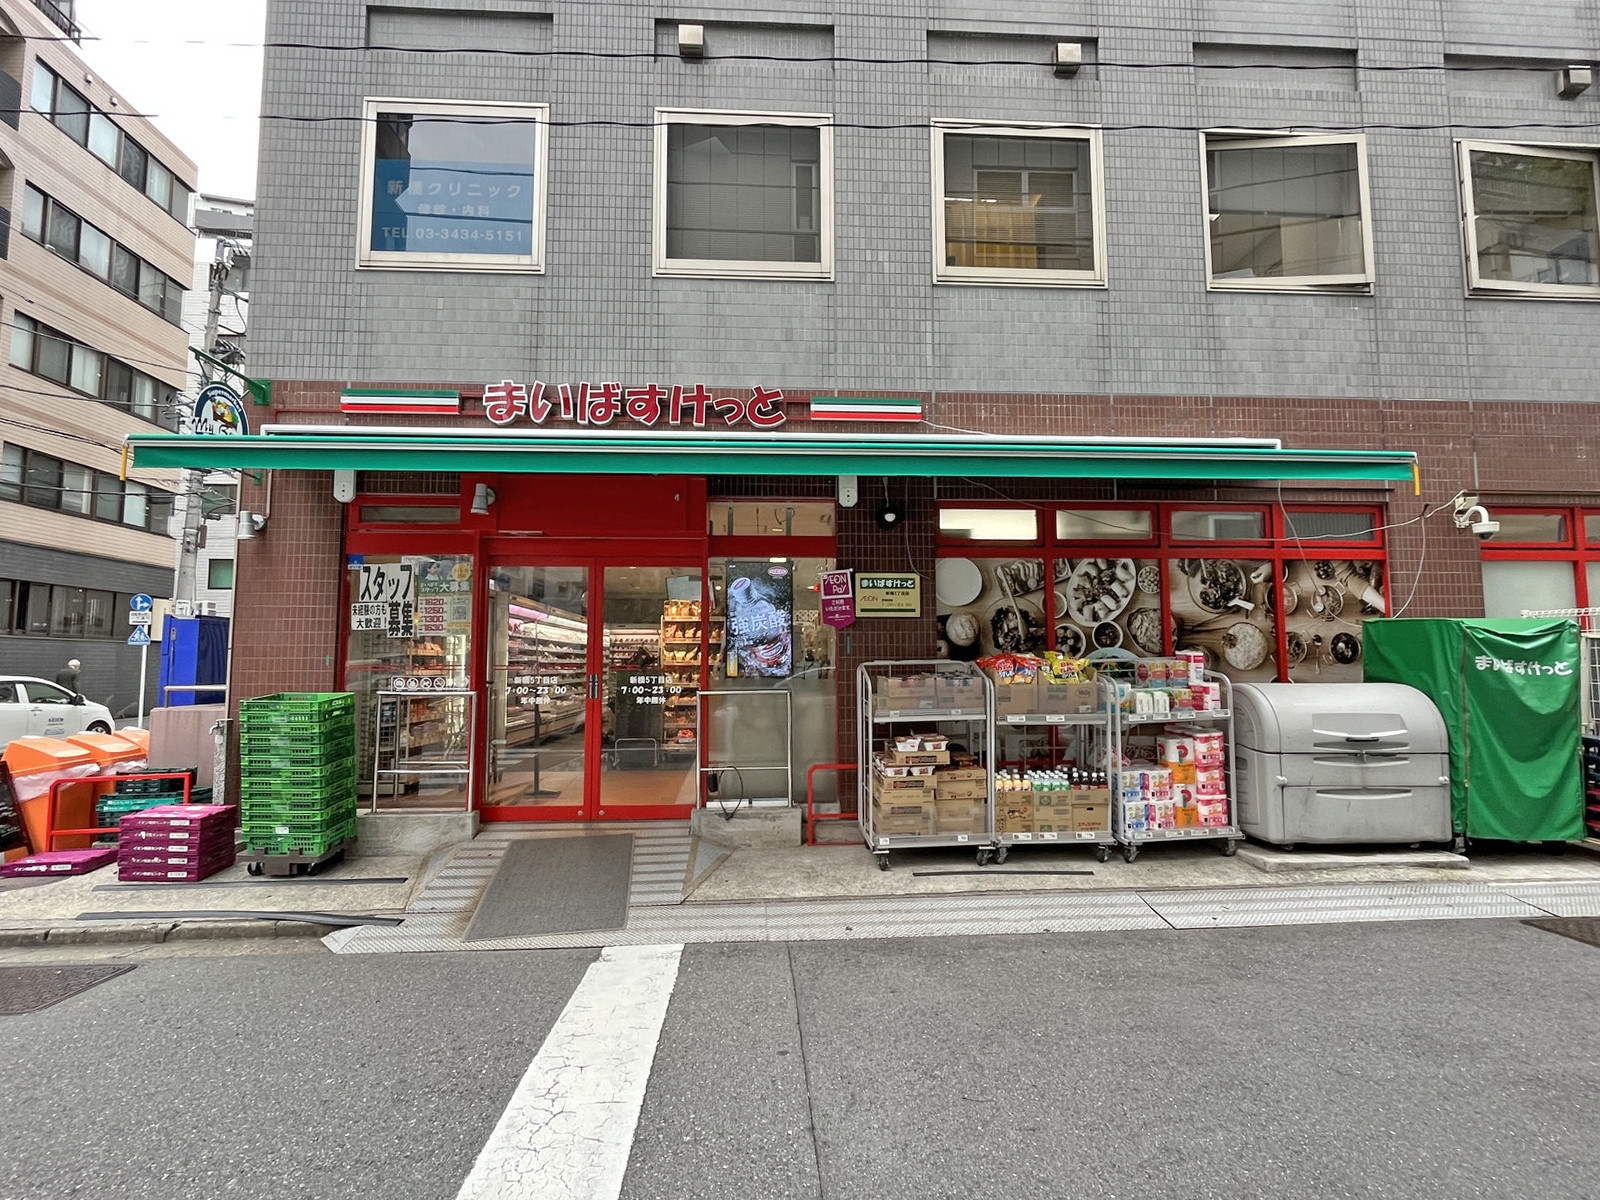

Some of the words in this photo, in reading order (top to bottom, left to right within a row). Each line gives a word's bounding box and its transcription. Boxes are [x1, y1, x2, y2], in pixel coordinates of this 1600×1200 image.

[382, 227, 409, 238] TEL
[416, 228, 522, 242] 03-3434-5151
[483, 380, 787, 427] まいばすけっと
[360, 564, 412, 600] スタッフ
[861, 579, 914, 588] まいばすけっと
[731, 609, 786, 635] 強炭酸
